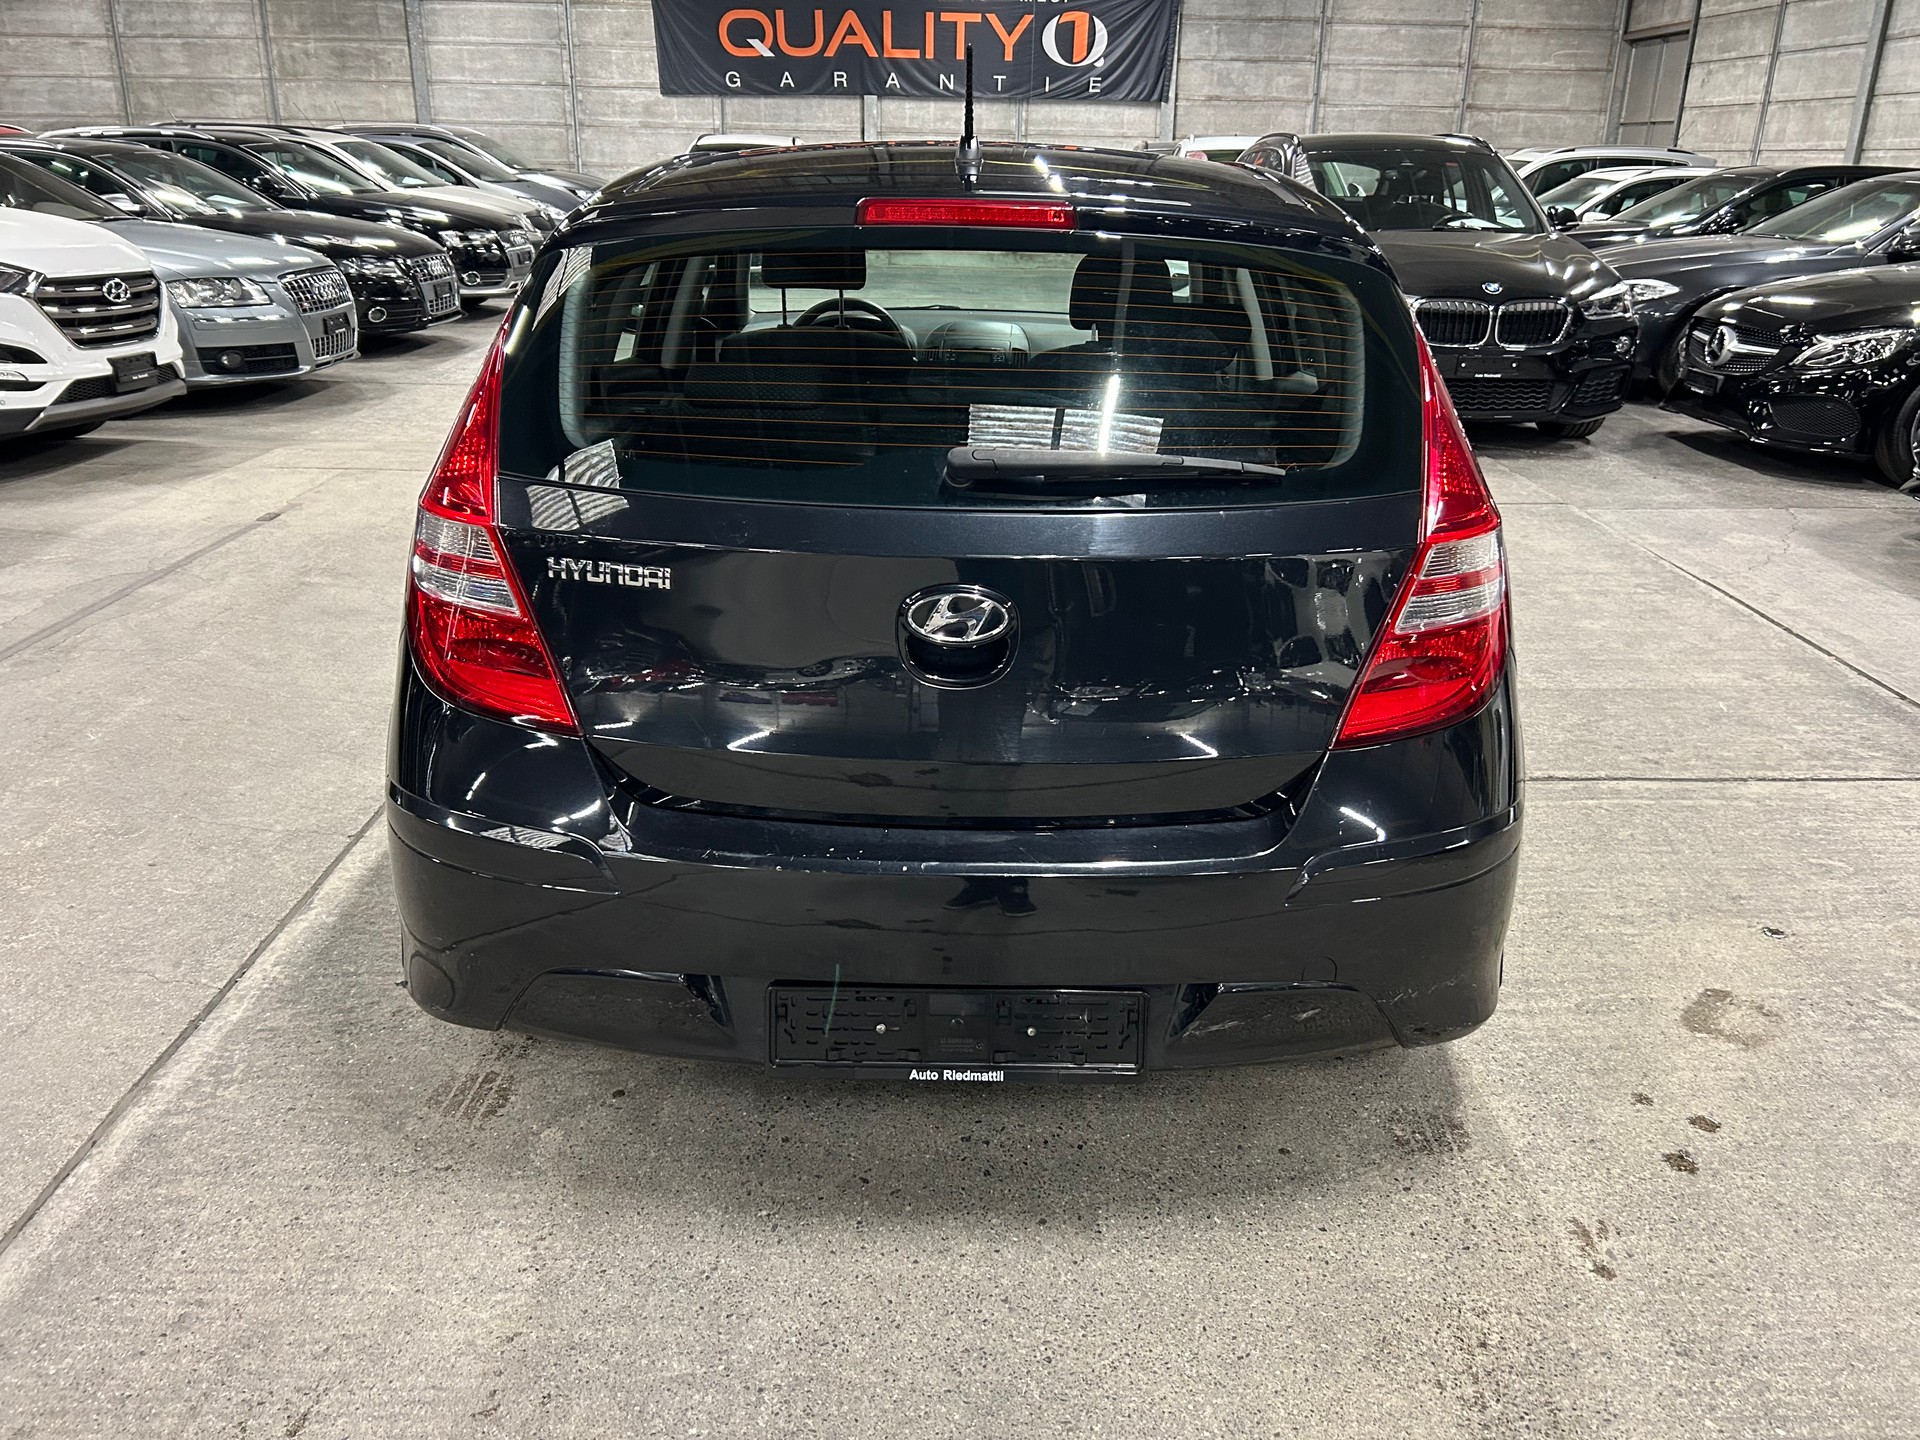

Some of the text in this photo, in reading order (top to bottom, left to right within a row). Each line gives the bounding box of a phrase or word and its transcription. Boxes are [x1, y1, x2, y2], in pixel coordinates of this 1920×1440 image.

[718, 9, 1034, 61] QUALITY
[725, 71, 1102, 93] GARANTIE
[547, 556, 671, 590] HYUNDAI
[909, 1068, 939, 1081] Auto
